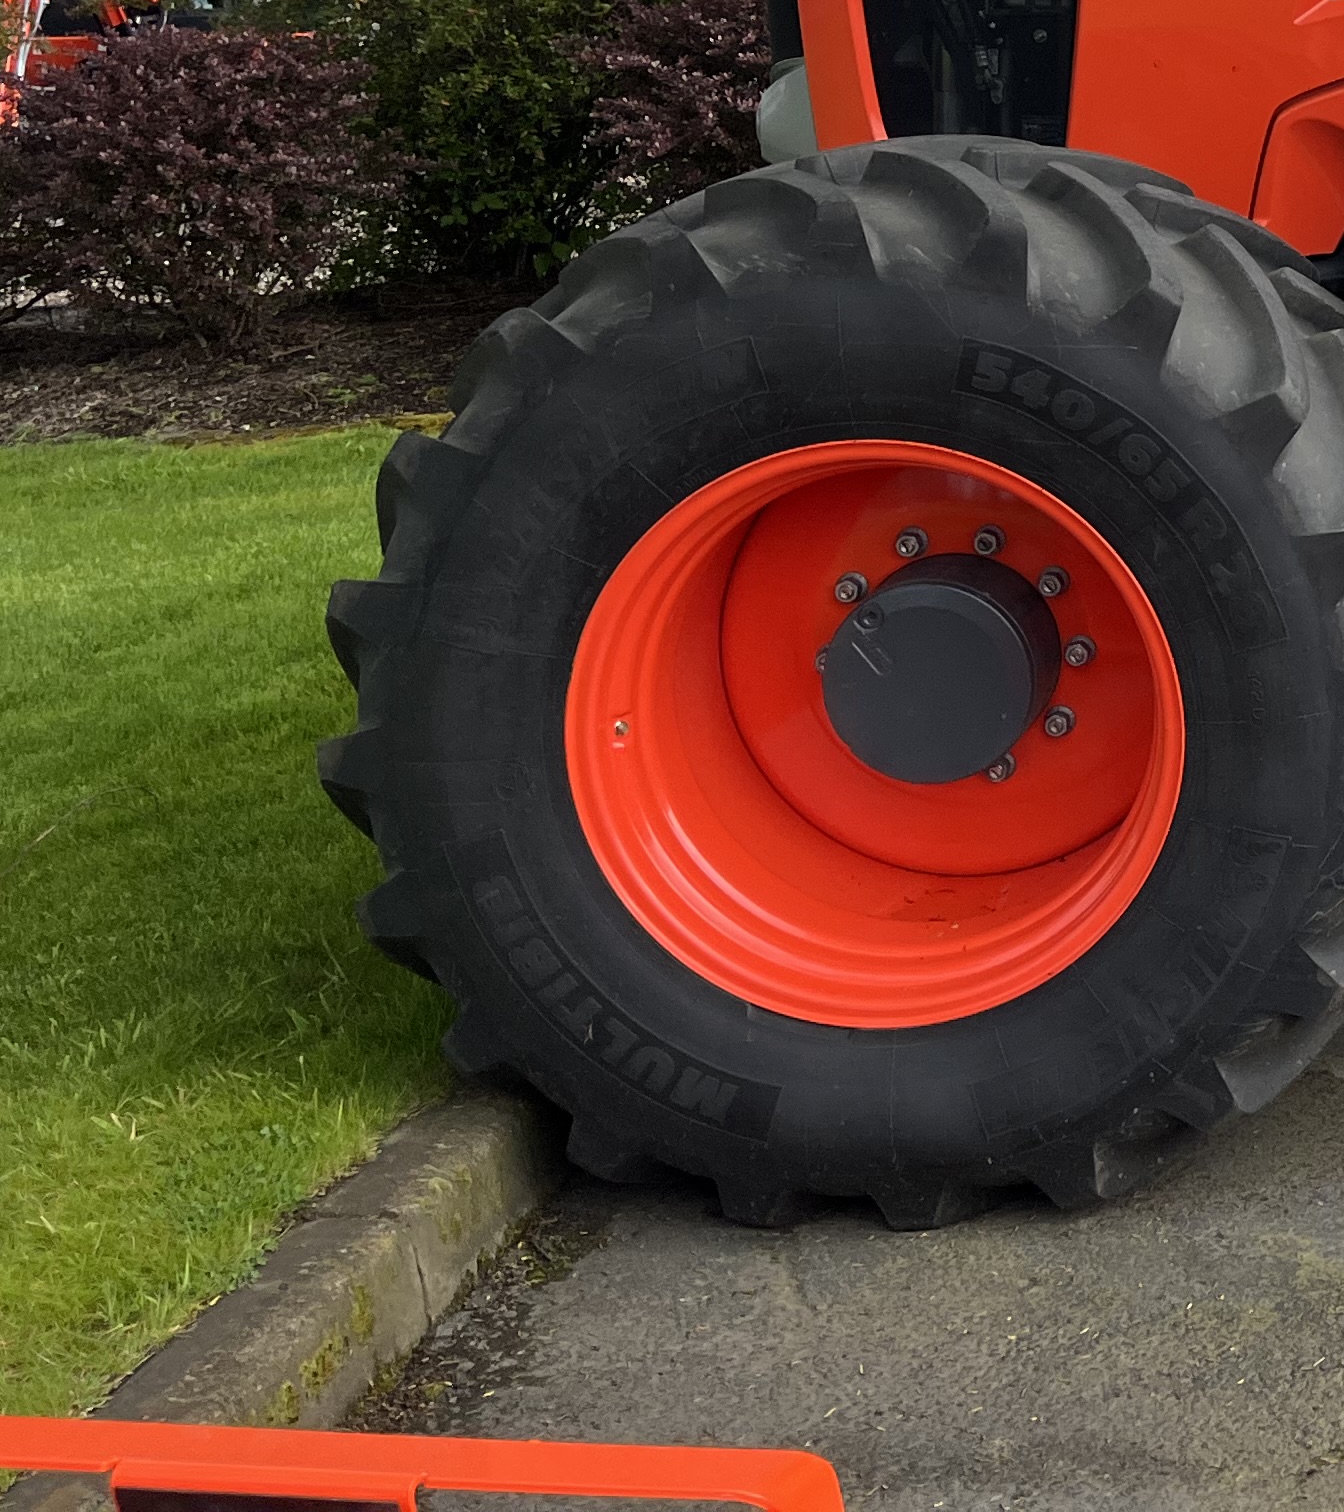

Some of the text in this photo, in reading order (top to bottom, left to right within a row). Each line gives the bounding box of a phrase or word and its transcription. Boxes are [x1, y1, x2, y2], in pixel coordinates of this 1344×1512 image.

[970, 349, 1193, 503] 540/65
[1176, 496, 1228, 555] R
[472, 875, 740, 1123] MULTIBIB
